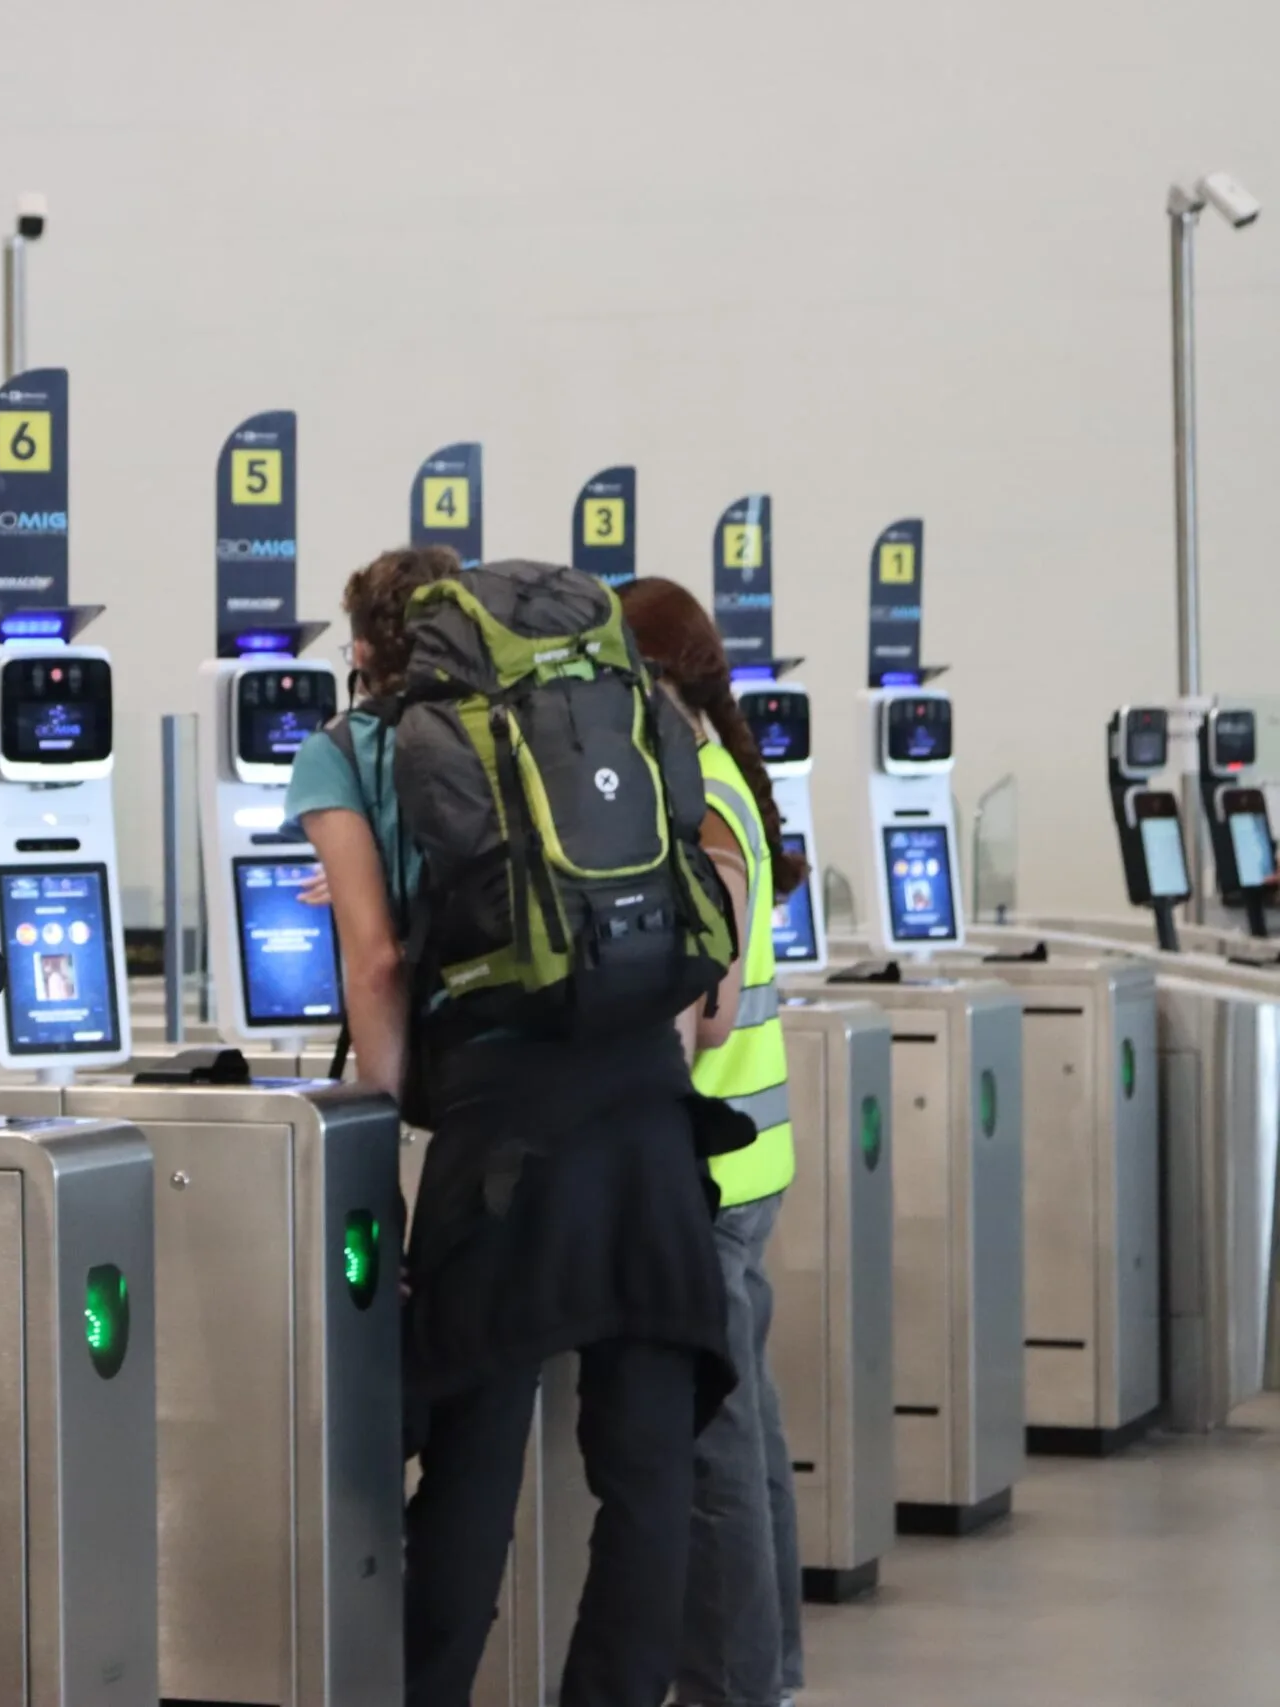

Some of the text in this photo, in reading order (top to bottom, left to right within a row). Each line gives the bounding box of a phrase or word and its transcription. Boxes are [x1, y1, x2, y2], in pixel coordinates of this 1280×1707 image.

[10, 421, 36, 461] 6
[246, 458, 268, 494] 5
[435, 486, 456, 519] 4
[596, 507, 613, 538] 3
[892, 552, 903, 575] 1
